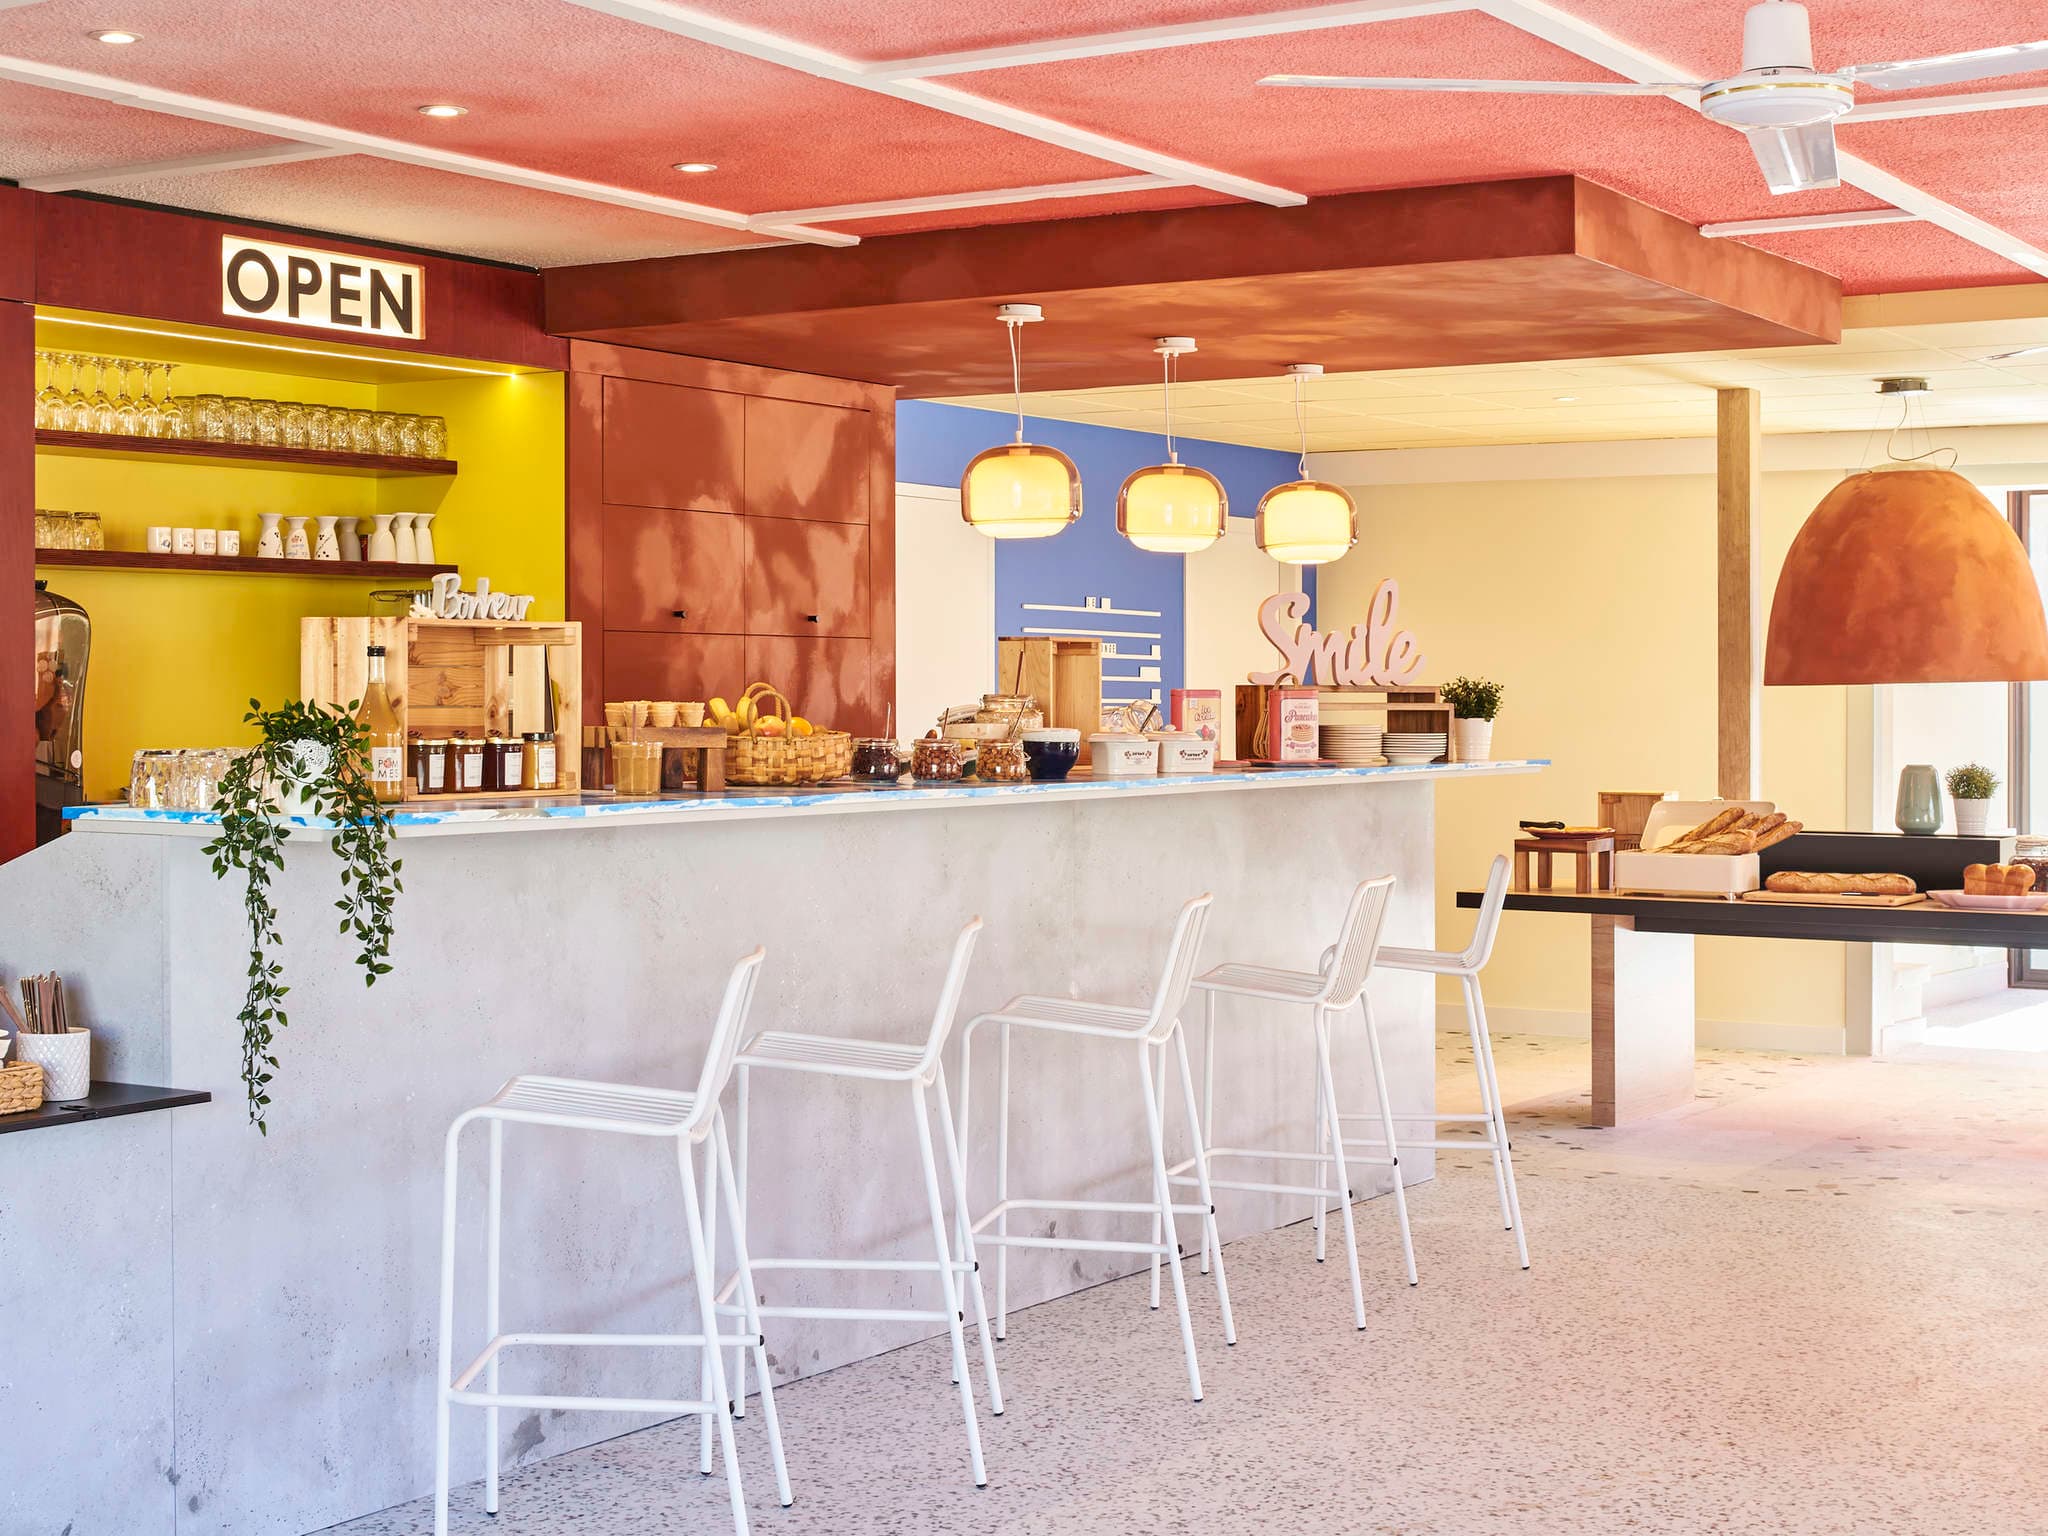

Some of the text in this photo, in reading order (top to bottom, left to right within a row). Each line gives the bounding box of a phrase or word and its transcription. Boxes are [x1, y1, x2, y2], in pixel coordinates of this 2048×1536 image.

[226, 248, 413, 334] OPEN
[431, 573, 535, 620] Bonheur
[1247, 578, 1426, 686] Smile
